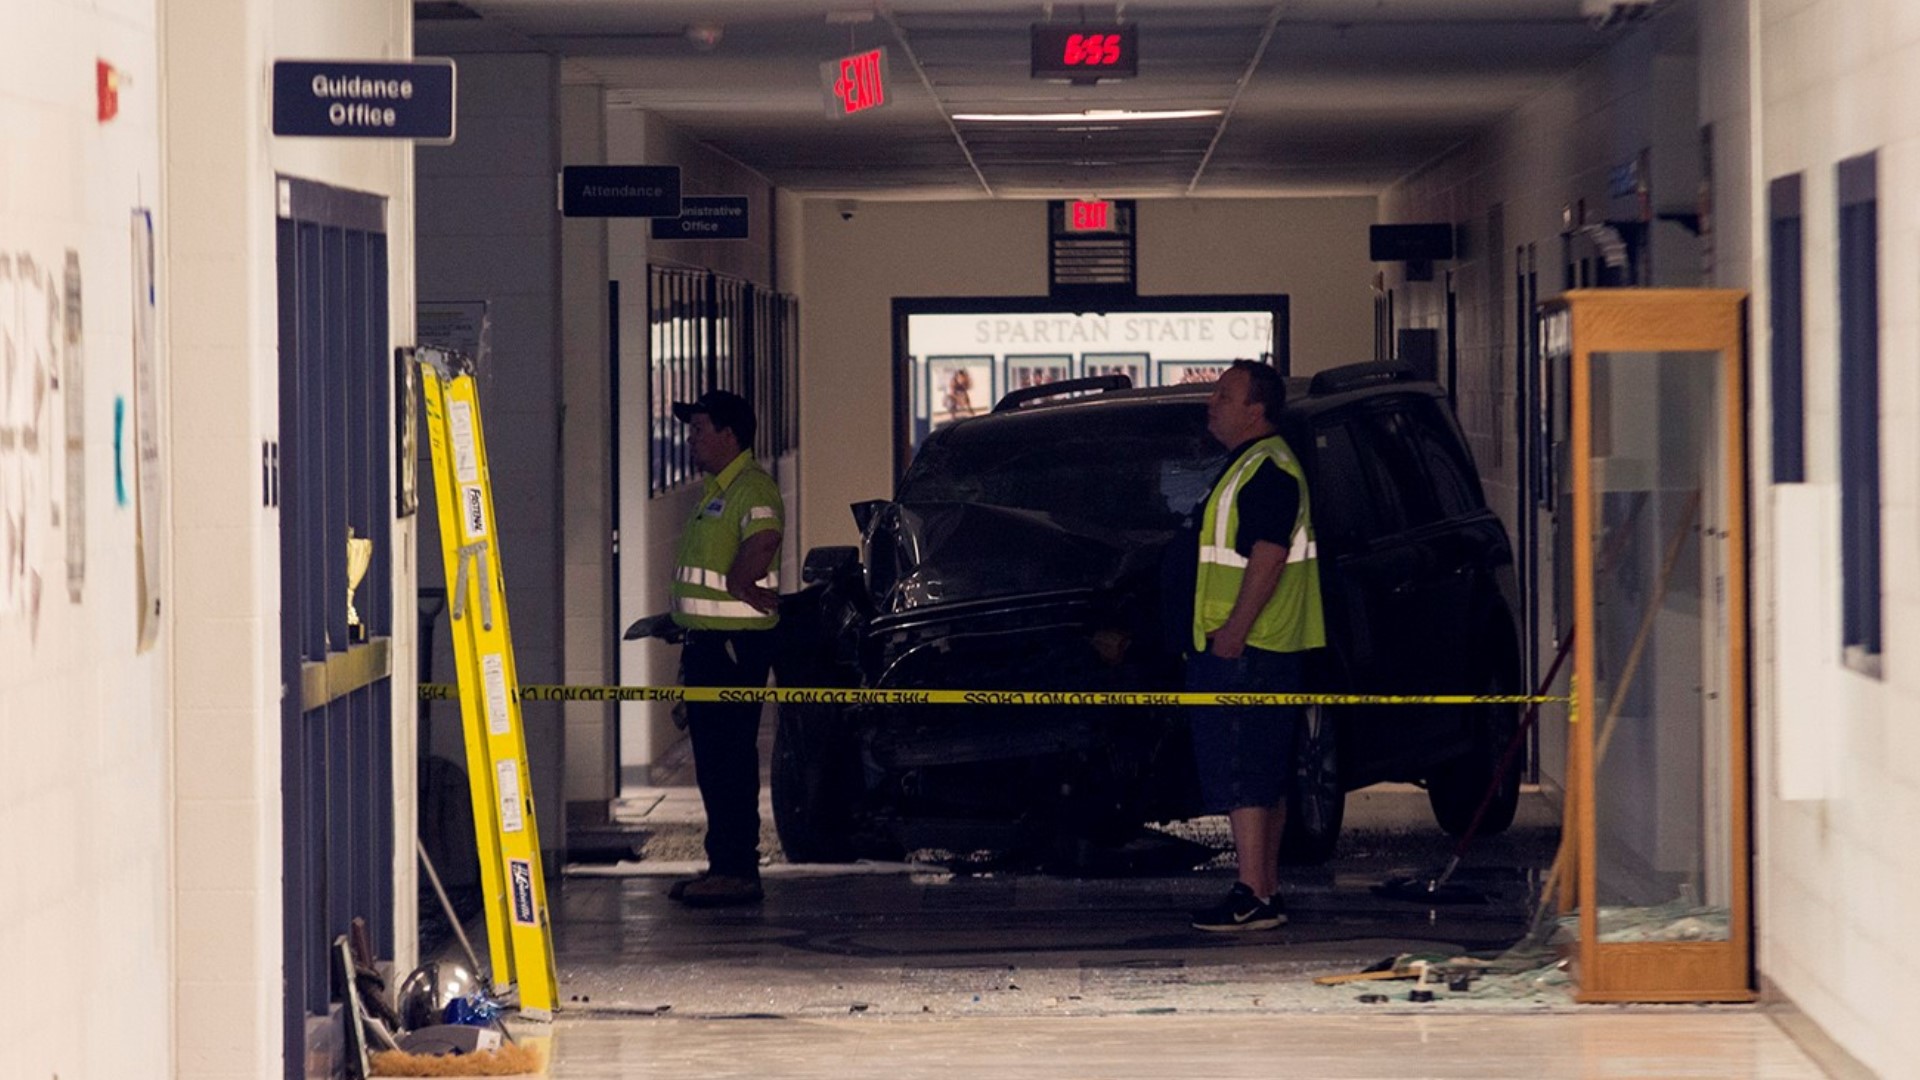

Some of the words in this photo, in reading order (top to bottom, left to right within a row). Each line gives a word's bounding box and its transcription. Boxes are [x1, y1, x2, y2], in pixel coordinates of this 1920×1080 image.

[312, 76, 413, 99] Guidance
[840, 49, 884, 114] EXIT
[329, 103, 396, 127] Office
[582, 184, 663, 199] Attendance
[681, 219, 719, 232] Office
[1073, 201, 1109, 229] EXIT
[975, 317, 1110, 344] SPARTAN
[1125, 317, 1214, 342] STATE
